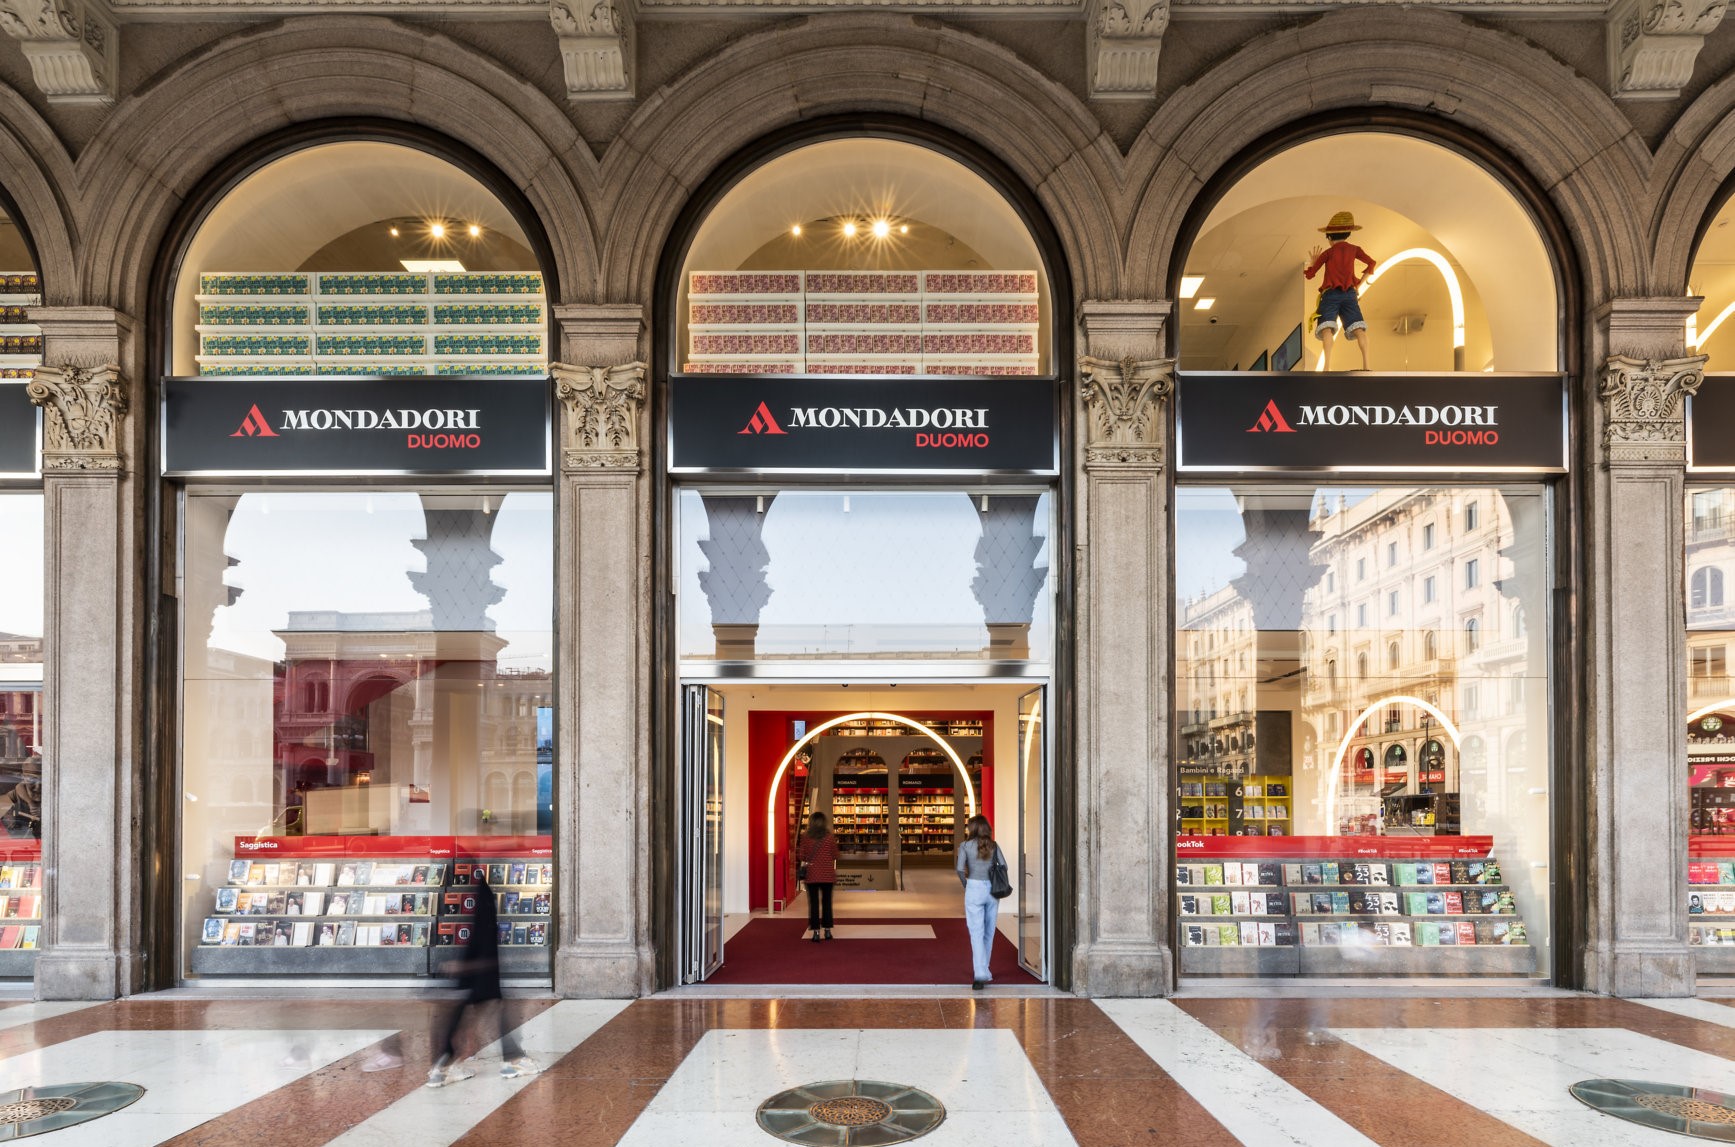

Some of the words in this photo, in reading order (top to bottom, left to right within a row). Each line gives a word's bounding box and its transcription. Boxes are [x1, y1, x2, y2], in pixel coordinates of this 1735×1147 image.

[280, 409, 480, 430] MONDADORI
[788, 407, 989, 428] MONDADORI
[1297, 405, 1498, 426] MONDADORI
[407, 434, 481, 449] DUOMO
[916, 433, 989, 448] DUOMO
[1425, 430, 1499, 445] DUOMO
[1235, 786, 1243, 797] 6
[1235, 809, 1243, 819] 7
[239, 841, 278, 850] Saggistica
